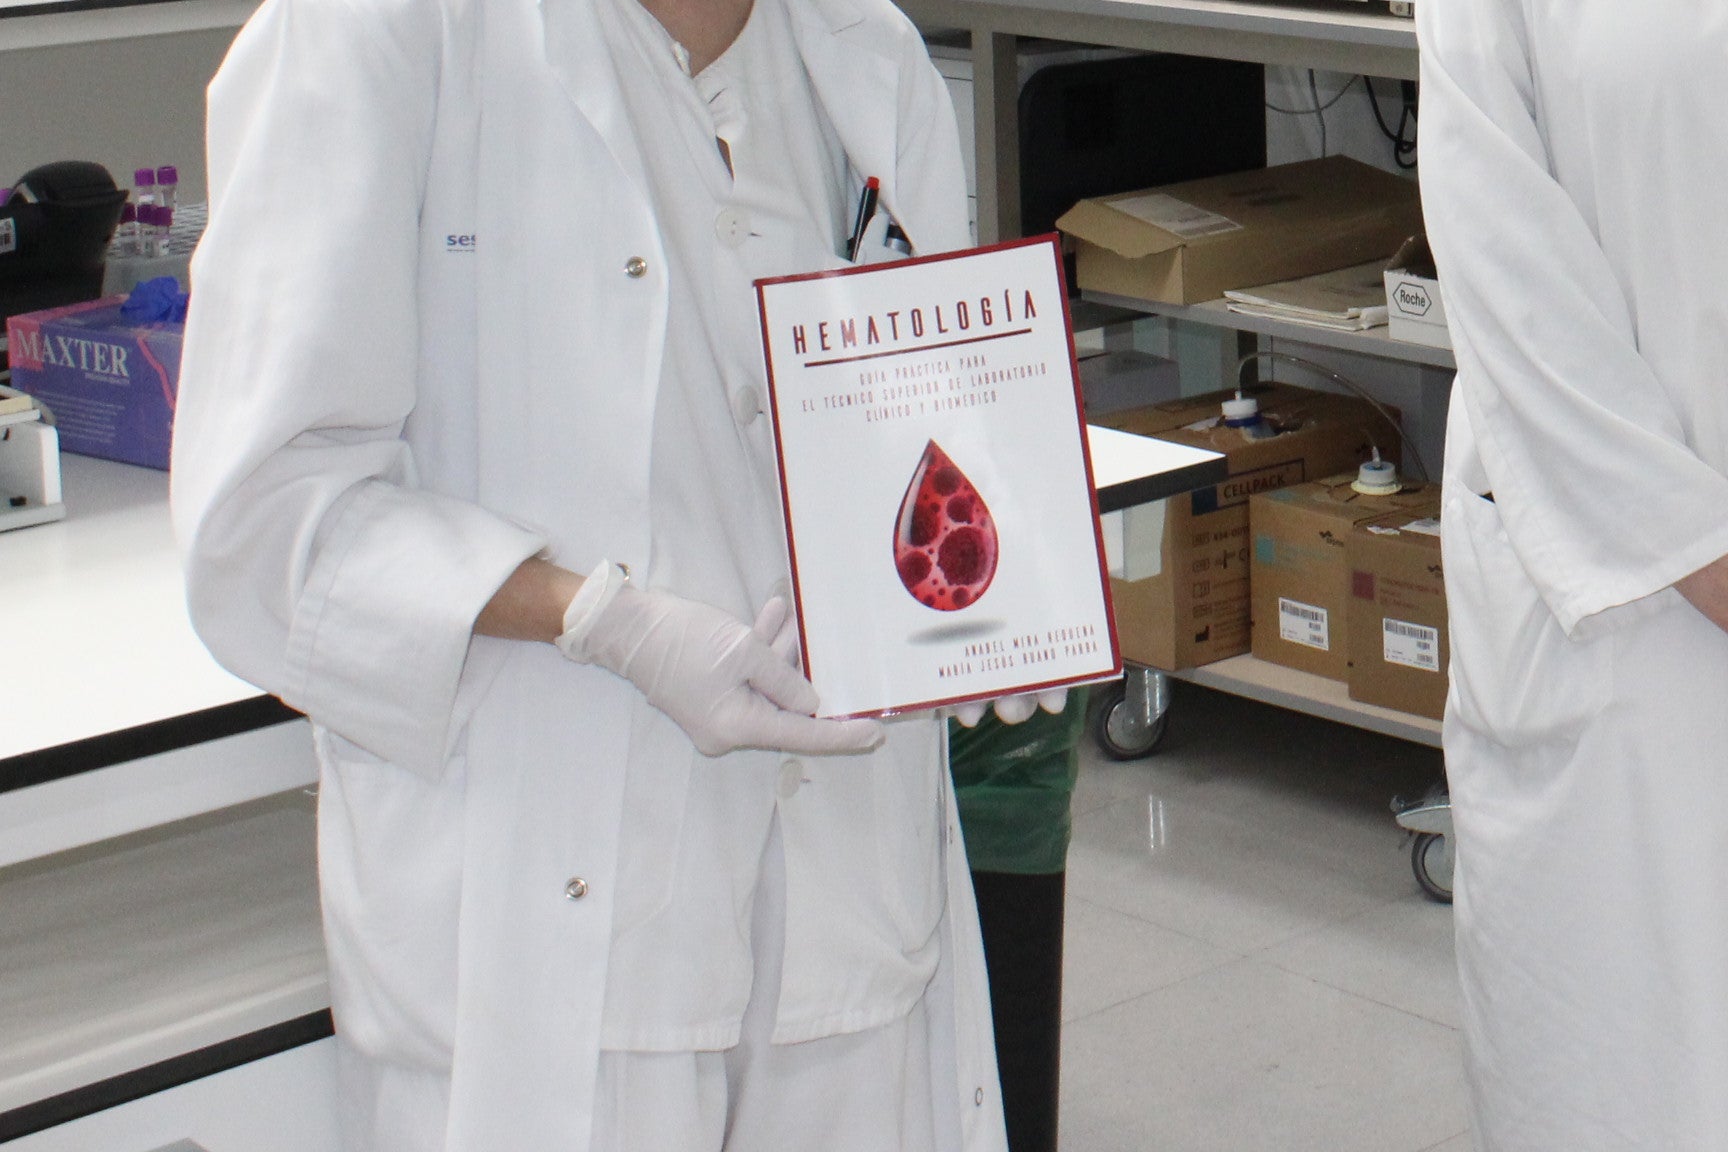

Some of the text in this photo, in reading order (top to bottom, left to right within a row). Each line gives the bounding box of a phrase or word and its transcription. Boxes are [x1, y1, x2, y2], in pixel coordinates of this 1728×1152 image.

[1400, 289, 1426, 307] Roche
[793, 290, 1037, 354] HEMATOLOGÍA
[16, 328, 130, 378] MAXTER
[960, 354, 987, 371] PARA
[802, 399, 815, 412] EL
[883, 380, 940, 401] SUPERIOR
[949, 377, 962, 391] DE
[970, 362, 1048, 388] LABORATORIO
[1223, 474, 1285, 499] CELLPACK
[965, 624, 1096, 657] ANABEL MIRA REQUENA
[1023, 648, 1057, 665] RUANO
[1065, 641, 1098, 657] PARRA
